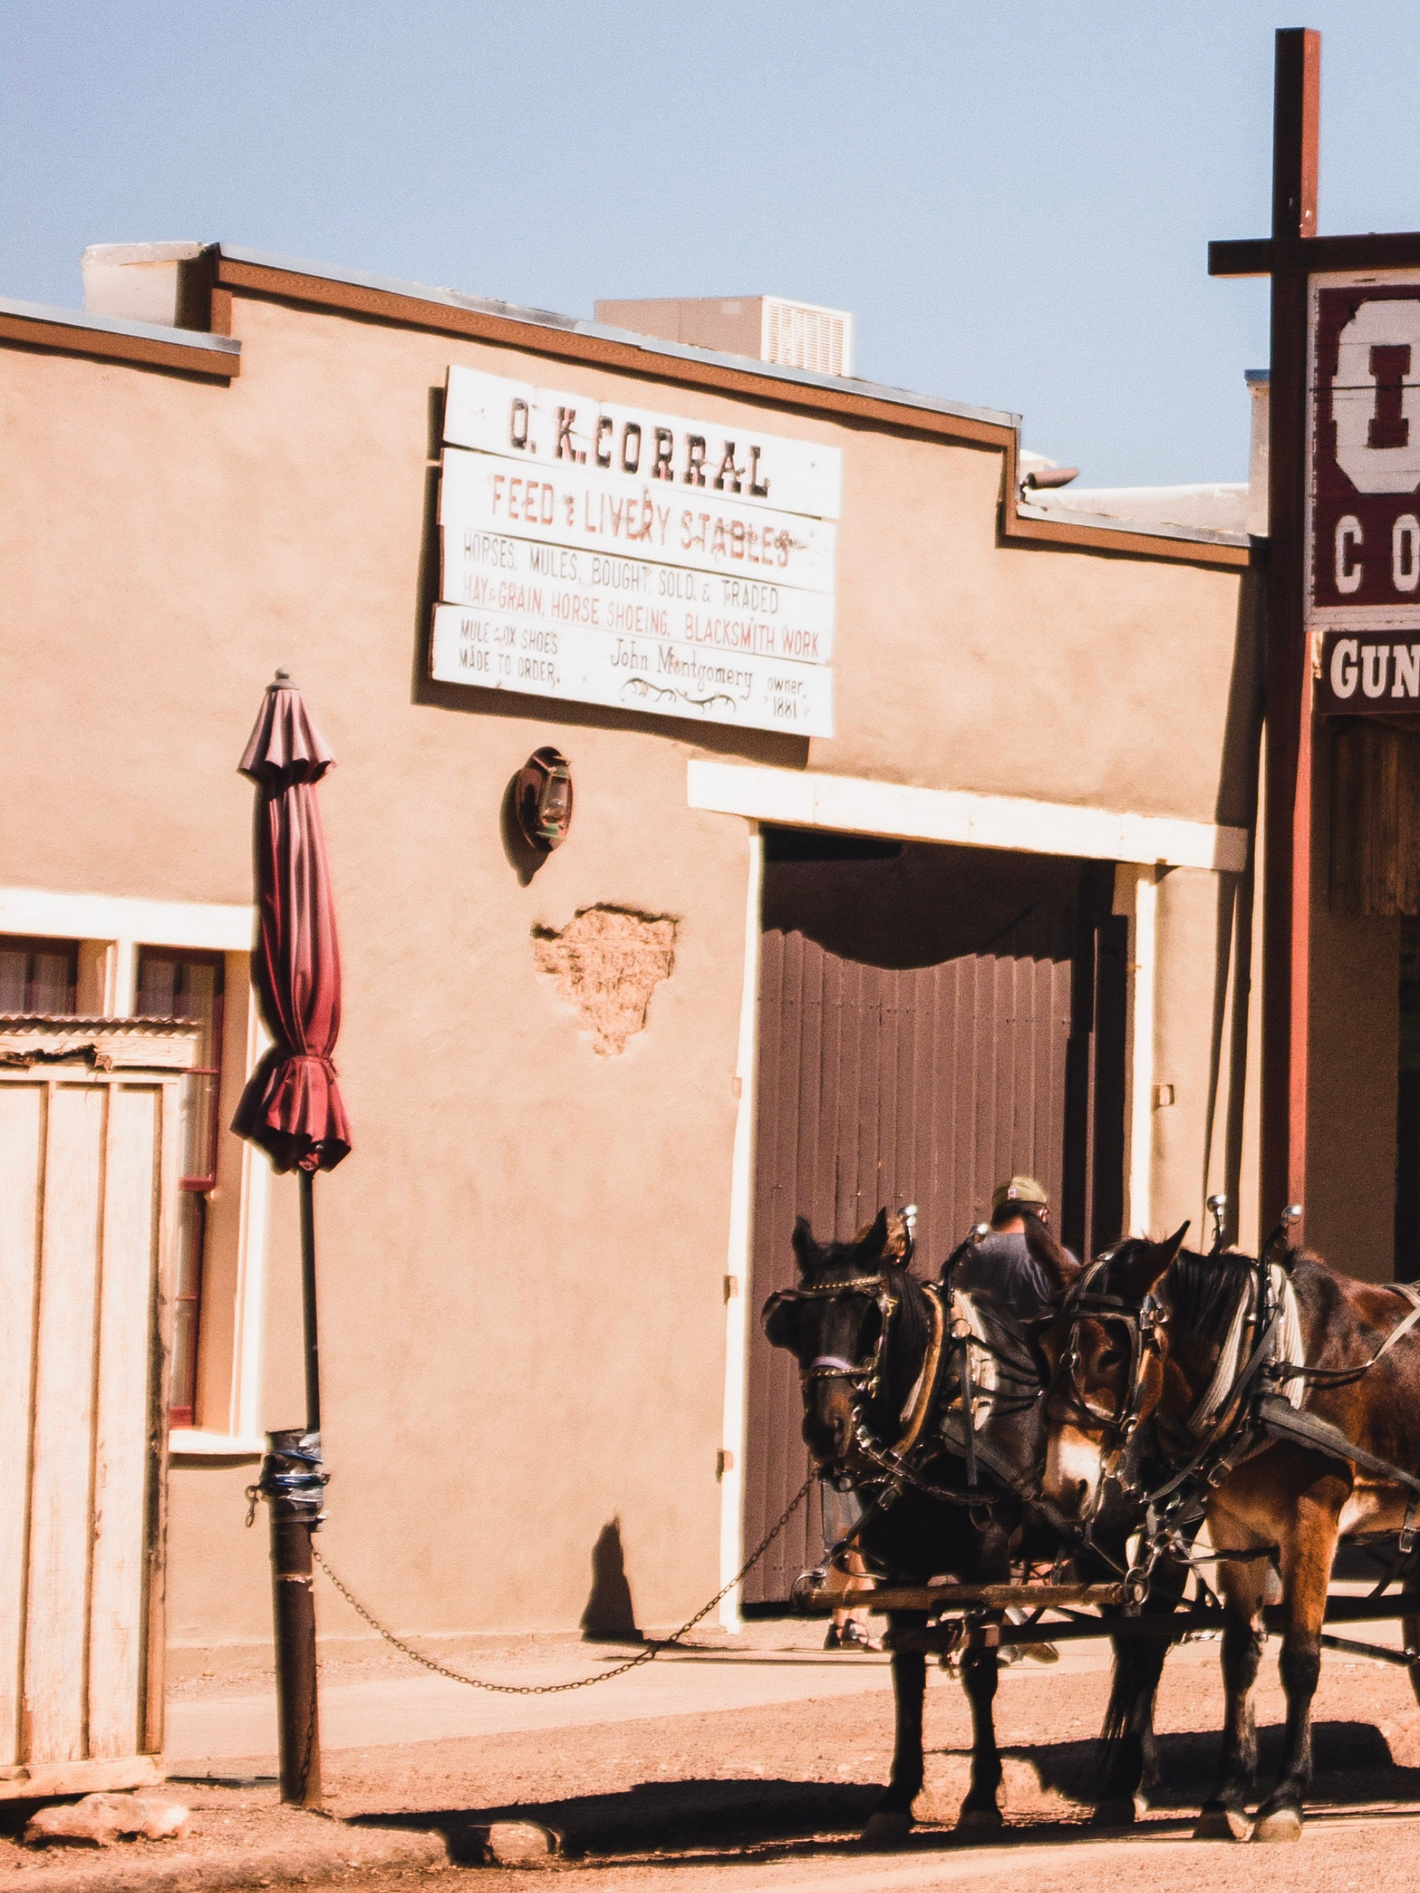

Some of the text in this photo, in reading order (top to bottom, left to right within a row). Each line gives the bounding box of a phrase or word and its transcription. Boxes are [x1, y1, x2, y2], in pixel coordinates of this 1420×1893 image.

[490, 473, 556, 527] FEED
[584, 486, 672, 551] LIVERY
[680, 507, 792, 570] STABLES
[720, 578, 779, 615] TRADED
[460, 618, 491, 643] MULE
[520, 627, 559, 655] SHOES
[550, 591, 600, 627] HORSE
[685, 611, 775, 653] BLACKSMITH
[782, 624, 819, 658] WORK
[459, 647, 490, 674] MADE
[497, 652, 512, 676] TO
[610, 638, 753, 701] John Montgomery
[772, 697, 798, 720] 1881
